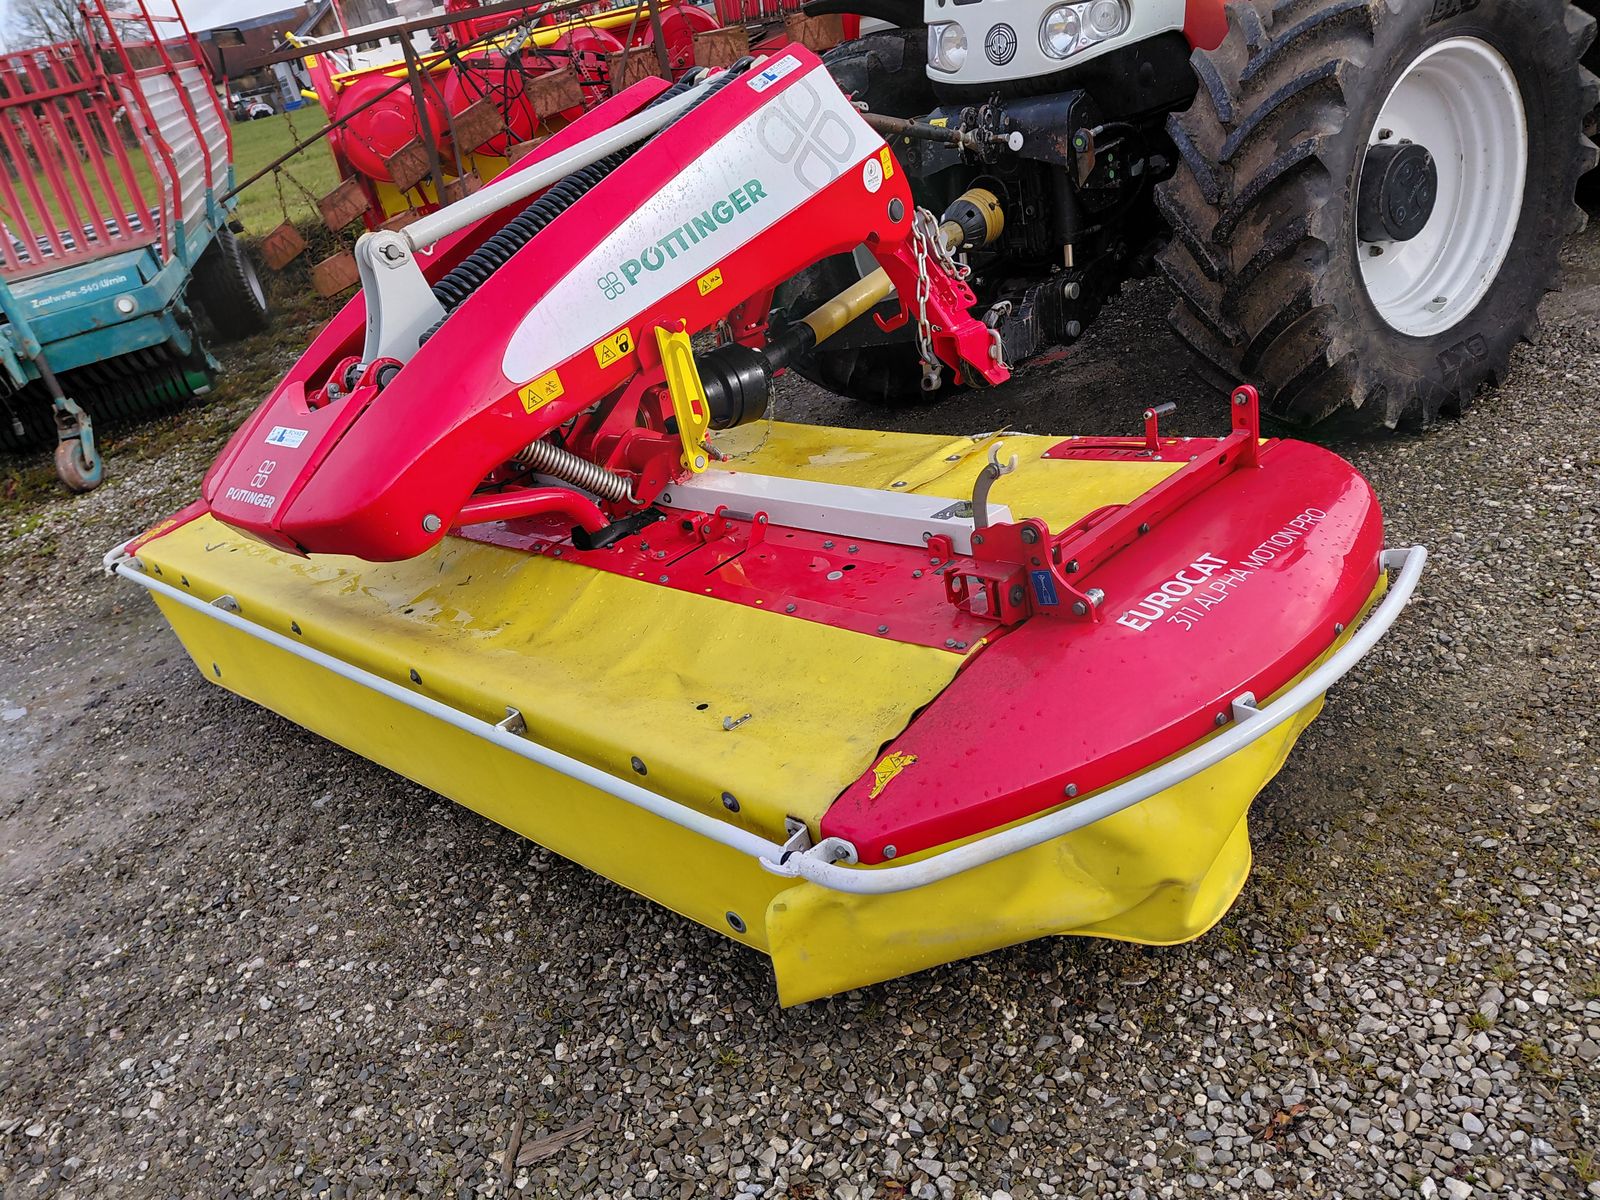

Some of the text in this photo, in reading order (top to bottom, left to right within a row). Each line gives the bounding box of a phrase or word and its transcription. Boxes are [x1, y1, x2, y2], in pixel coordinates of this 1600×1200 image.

[1116, 552, 1228, 632] EUROCAT
[1166, 507, 1327, 631] 311 ALPHA MOTION PRO
